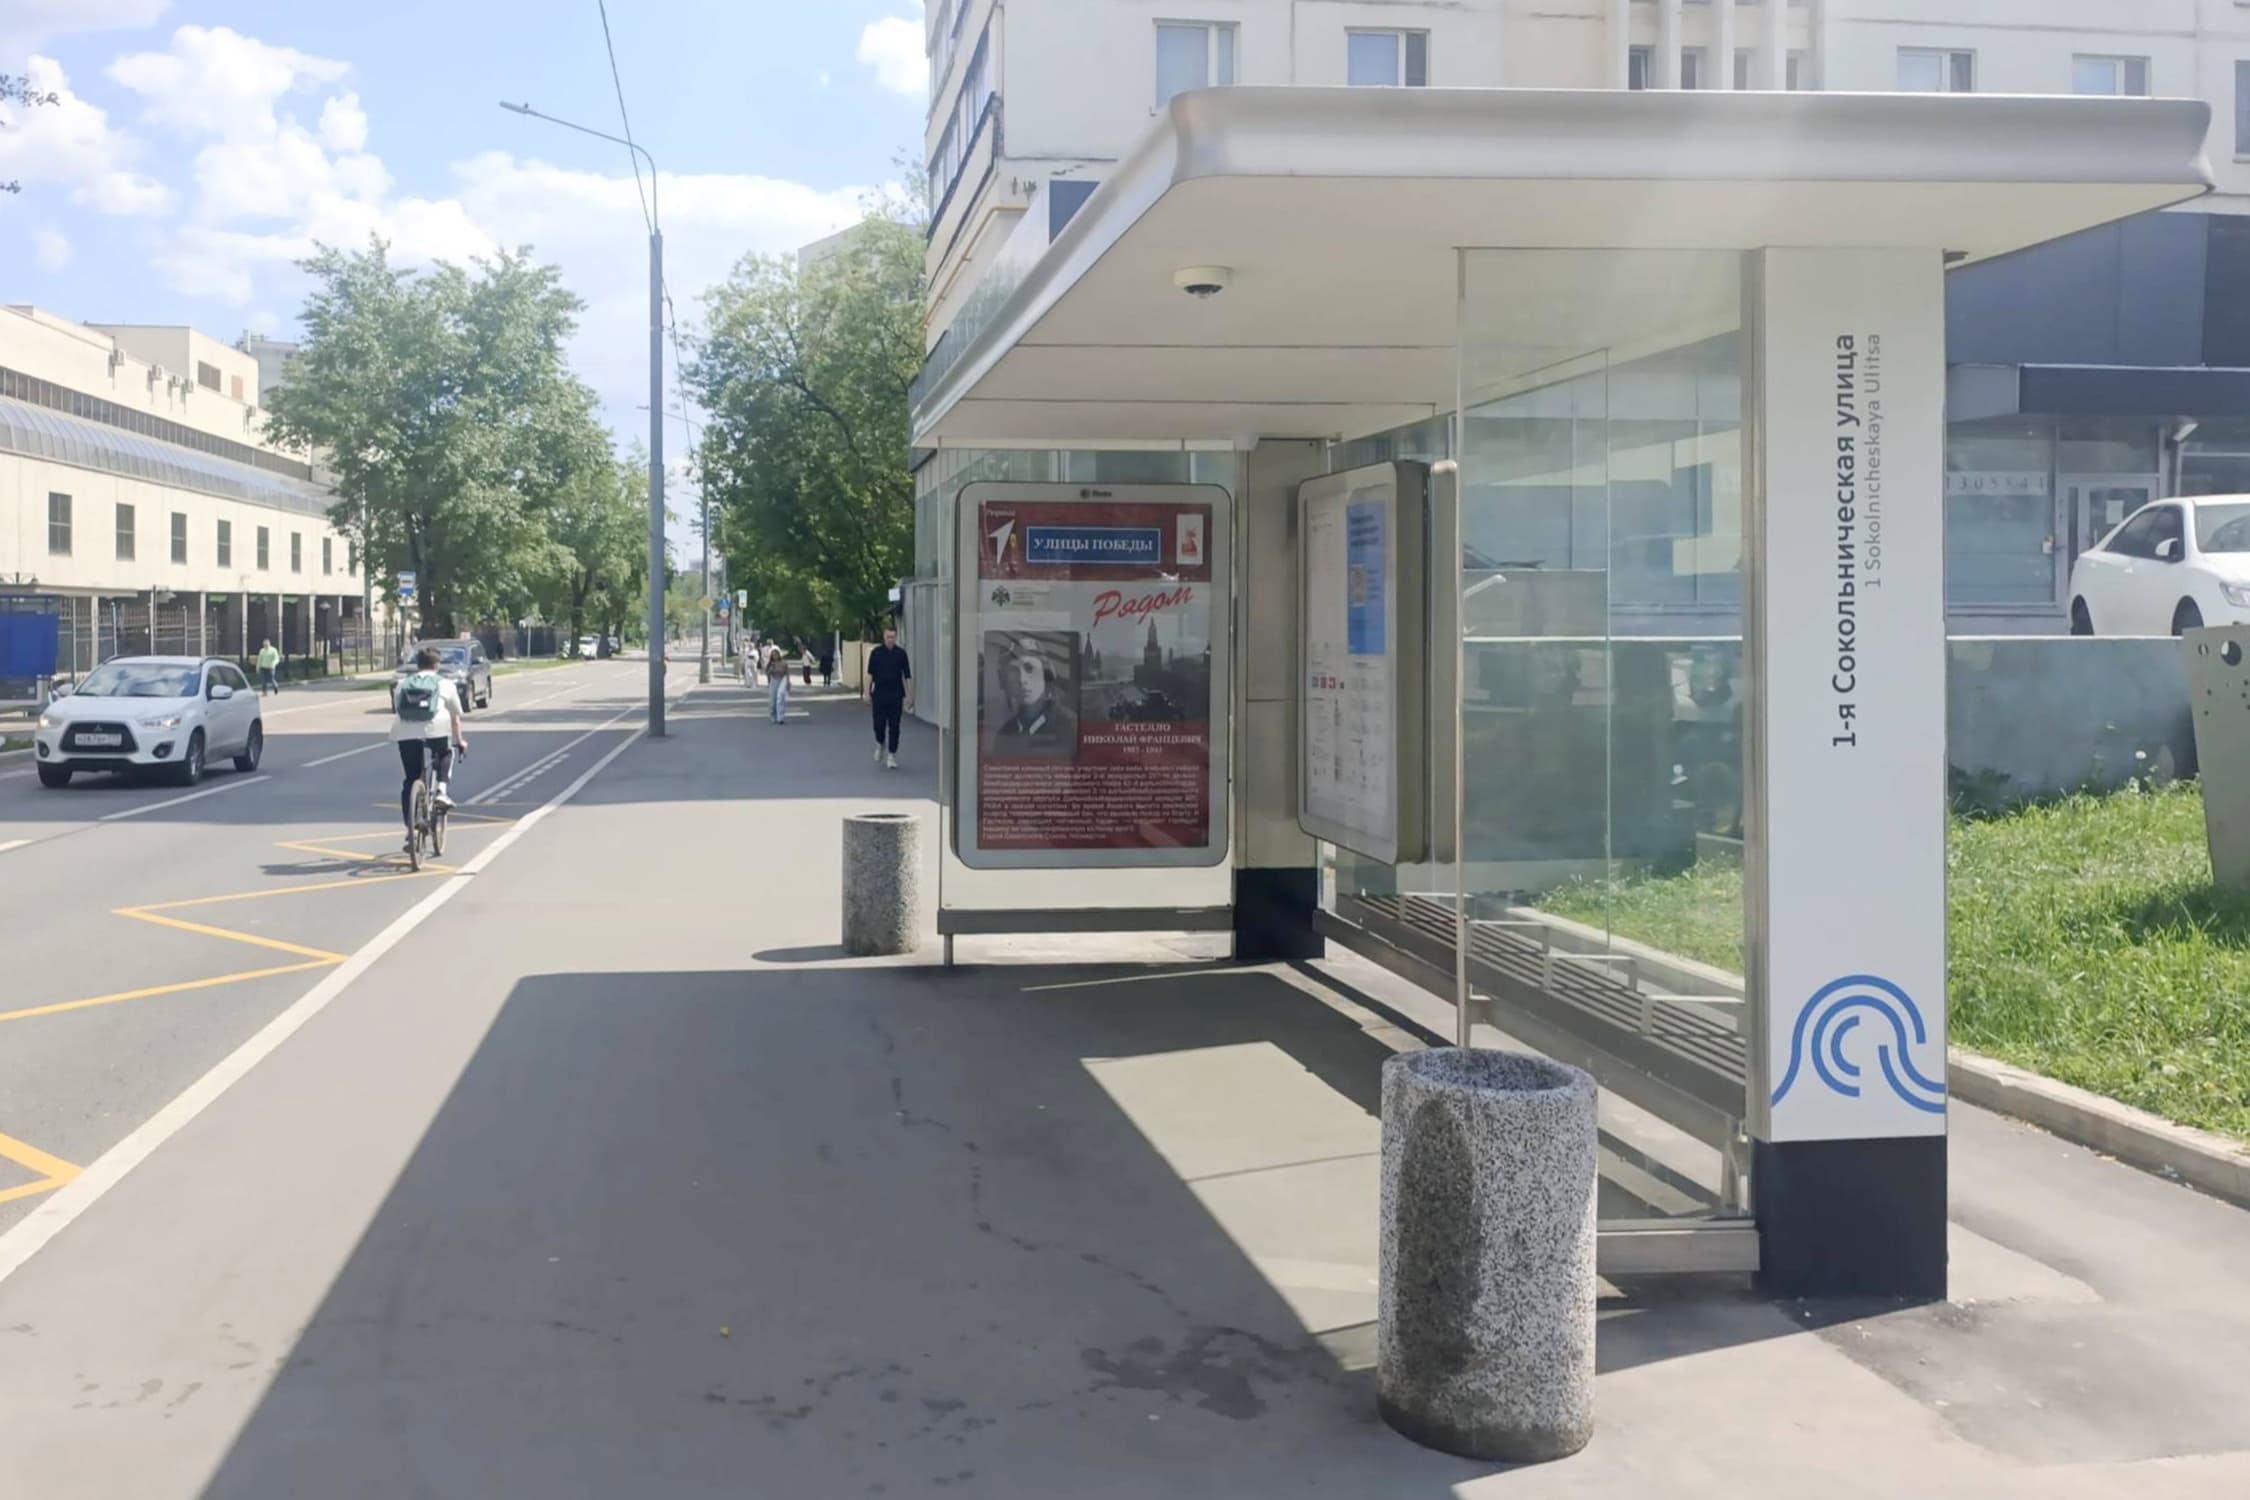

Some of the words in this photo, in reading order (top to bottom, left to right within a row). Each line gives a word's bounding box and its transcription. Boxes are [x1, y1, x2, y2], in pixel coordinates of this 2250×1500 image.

[1832, 334, 1861, 427] улица
[1864, 334, 1882, 394] Ulitsa
[1864, 400, 1884, 571] Sokolnicheskaya
[1033, 538, 1089, 551] УЛИЦЫ
[1092, 539, 1153, 553] ПОБЕДЫ
[1831, 436, 1857, 694] Сокольническая
[1865, 578, 1881, 588] 1
[1092, 586, 1194, 628] Рядом
[1083, 734, 1137, 744] НИКОЛАЙ
[1115, 723, 1171, 732] ГАСТЕЛЛО
[1832, 703, 1857, 748] 1-я
